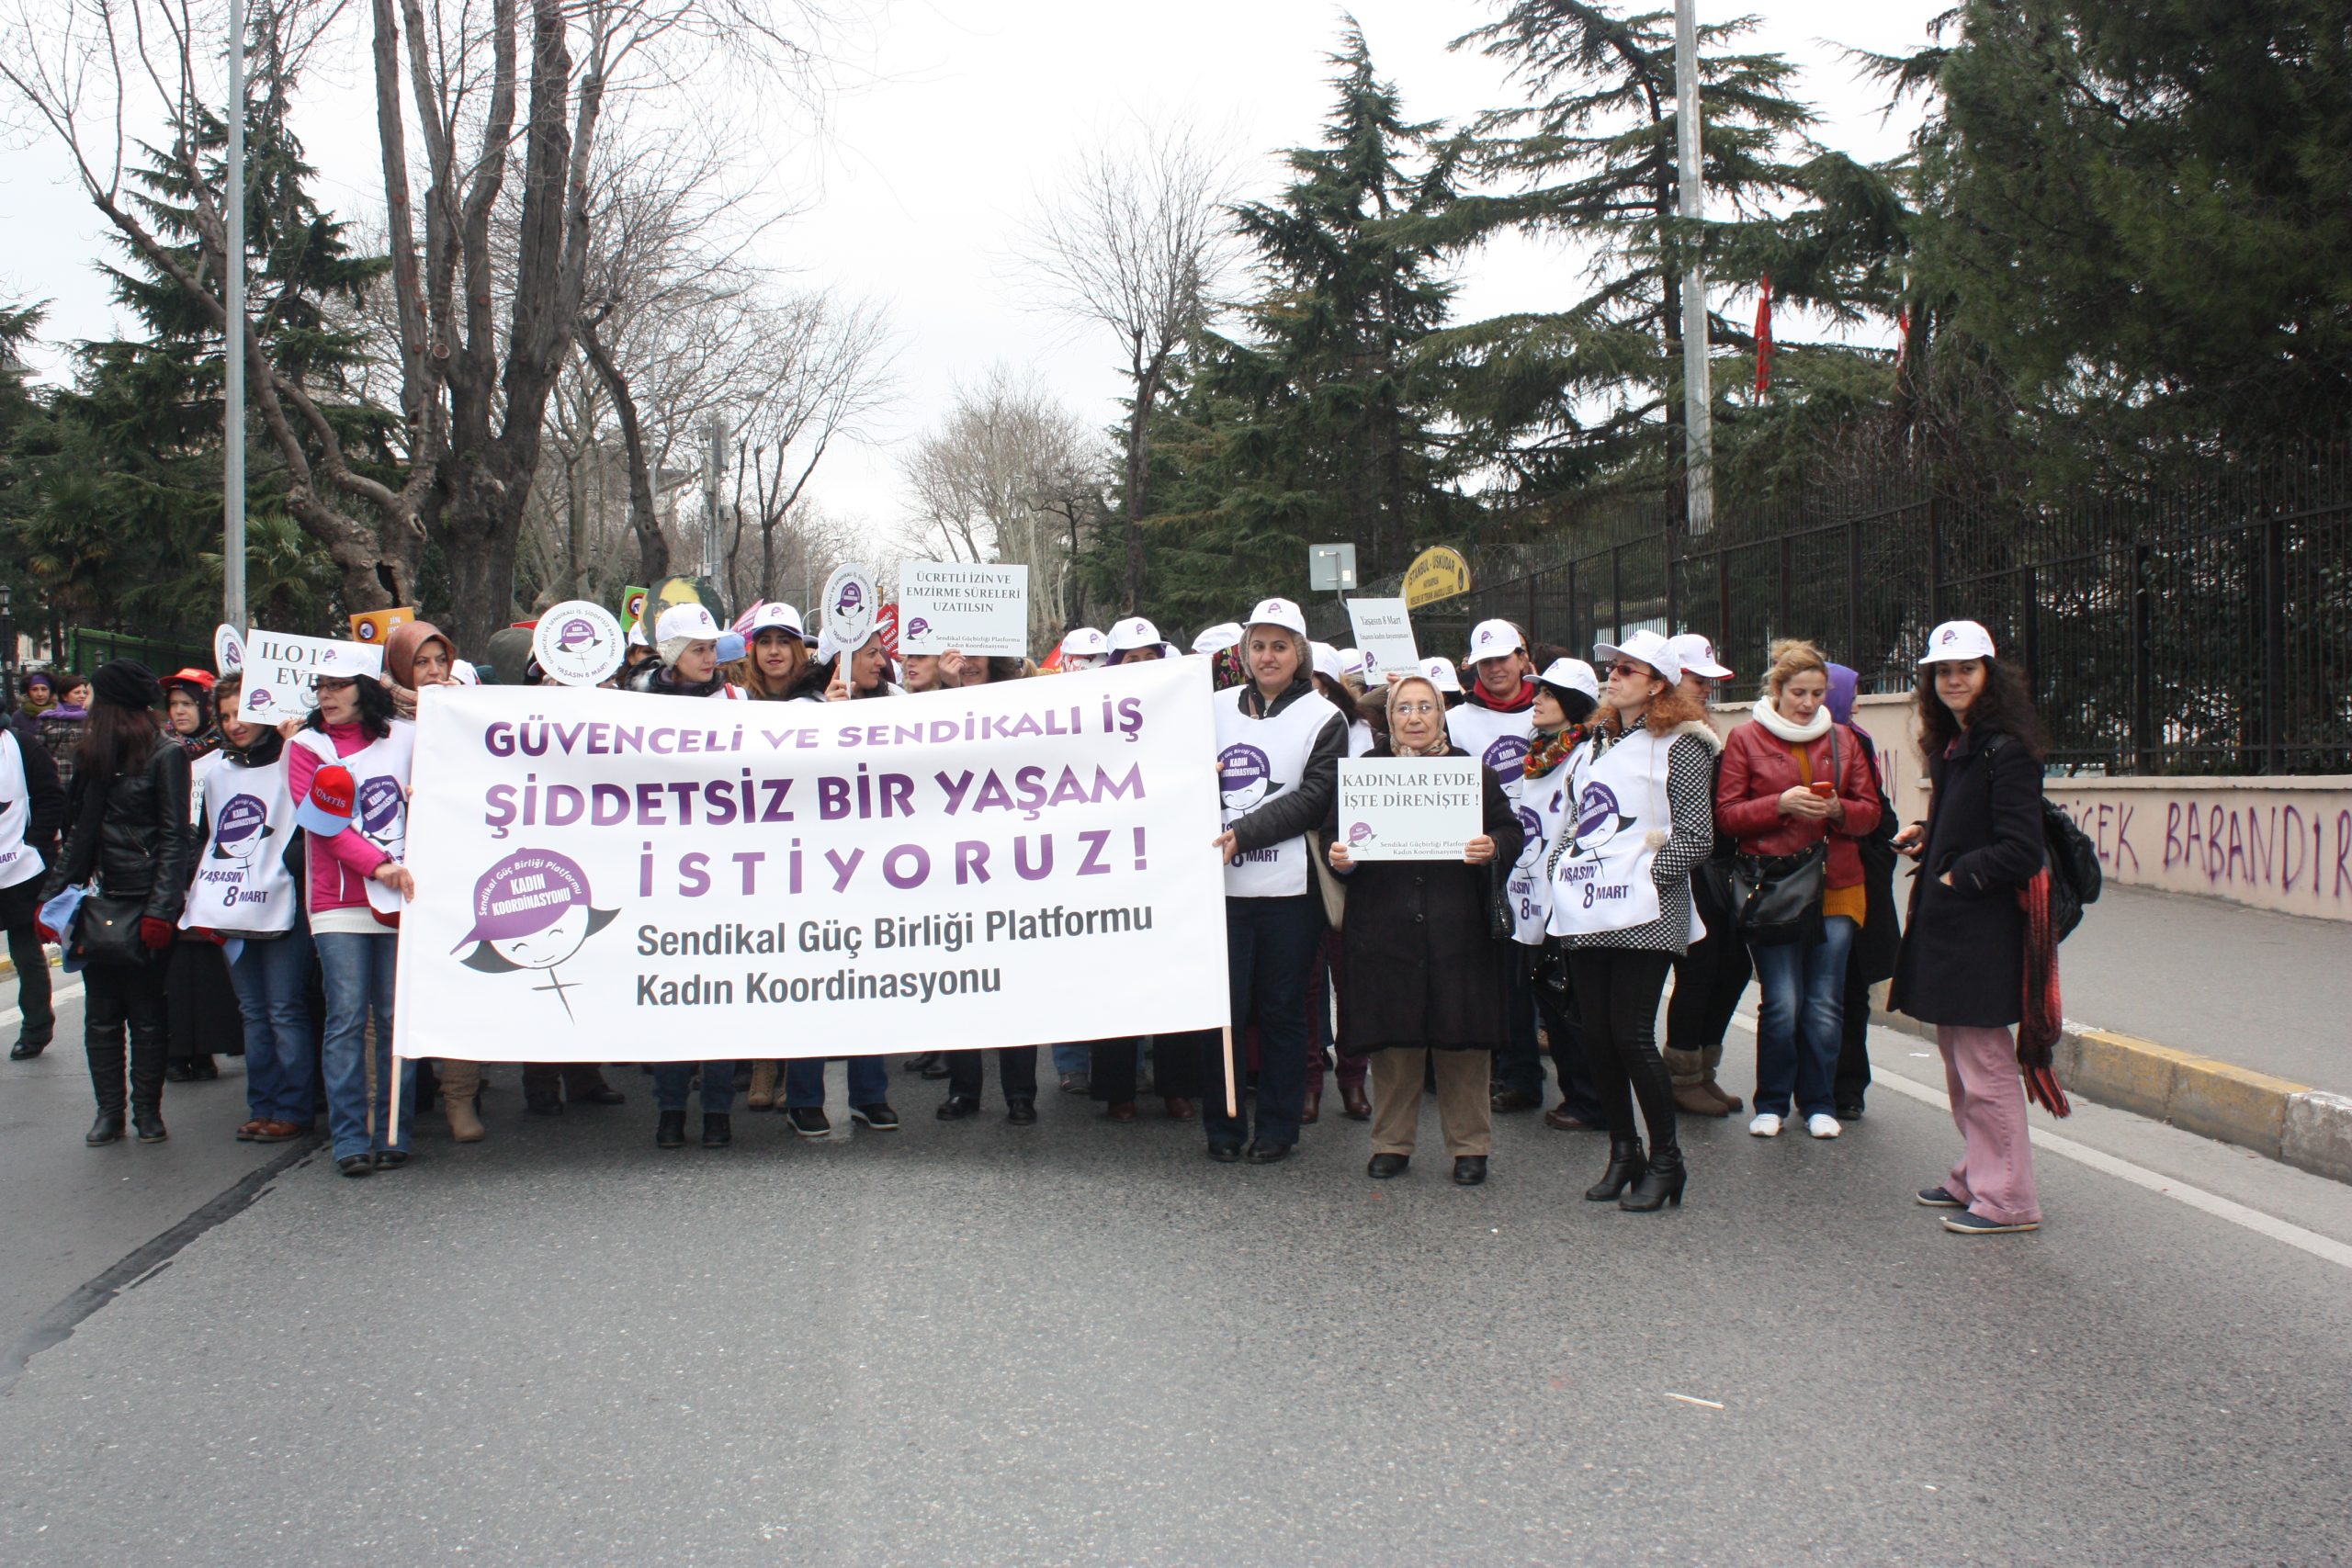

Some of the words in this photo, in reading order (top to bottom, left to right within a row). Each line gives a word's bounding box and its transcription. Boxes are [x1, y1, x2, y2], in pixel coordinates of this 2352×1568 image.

[916, 570, 966, 583] ÜCRETLİ
[969, 571, 994, 584] İZİN
[997, 574, 1012, 584] VE
[906, 585, 961, 597] EMZİRME
[964, 587, 1021, 599] SÜRELERİ
[933, 602, 994, 613] UZATILSIN
[1360, 615, 1383, 626] Yaşasın
[1383, 615, 1387, 626] 8
[1387, 615, 1402, 625] Mart
[262, 642, 303, 663] ILO
[484, 715, 743, 758] GÜVENCELİ
[761, 728, 820, 750] VE
[837, 705, 1082, 748] SENDİKALI
[1102, 694, 1144, 742] İŞ
[1229, 757, 1249, 768] KADIN
[1498, 747, 1517, 761] KADIN
[1221, 766, 1261, 778] OORDİNASYONU
[1342, 773, 1430, 787] KADINLAR
[1433, 773, 1480, 788] EVDE,
[484, 767, 795, 840] ŞİDDETSİZ
[817, 762, 916, 820] BİR
[933, 761, 1147, 821] YAŞAM
[1344, 792, 1378, 809] İŞTE
[1383, 791, 1470, 809] DİRENİŞTE
[1475, 794, 1479, 806] !
[1246, 850, 1279, 863] MART
[2163, 800, 2352, 900] BABANDIR
[198, 869, 244, 885] YAŞASIN
[510, 873, 547, 896] KADIN
[1558, 865, 1598, 886] YAŞASIN
[222, 886, 240, 907] 8
[239, 890, 269, 904] MART
[479, 879, 498, 917] Sendikal
[496, 865, 514, 881] Güç
[514, 858, 545, 870] Birliği
[546, 861, 582, 895] Platformu
[1582, 882, 1595, 909] 8
[1595, 885, 1629, 900] MART
[492, 887, 571, 917] KOORDİNASYONU
[1521, 897, 1531, 920] 8
[637, 922, 786, 956] Sendikal
[798, 919, 863, 959] Güç
[875, 912, 974, 952] Birliği
[986, 905, 1153, 942] Platformu
[637, 974, 733, 1007] Kadın
[746, 967, 1001, 1004] Koordinasyonu
